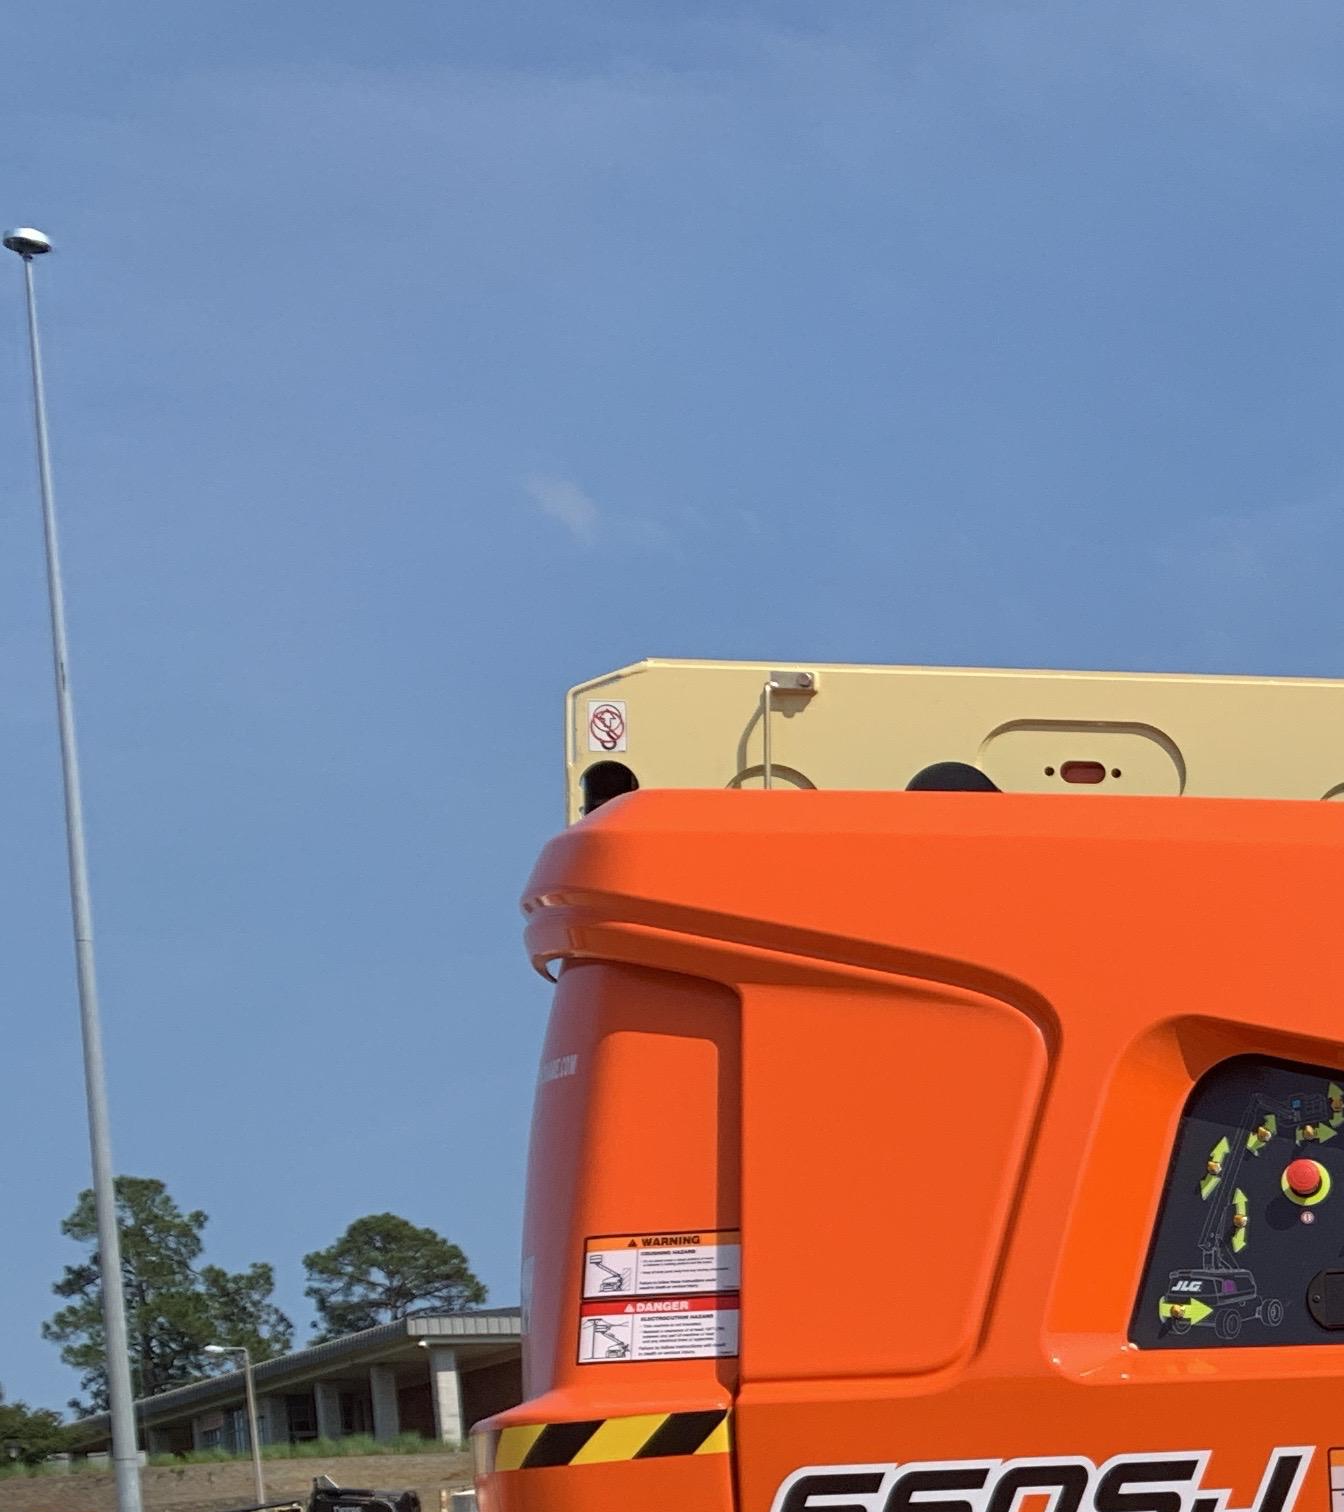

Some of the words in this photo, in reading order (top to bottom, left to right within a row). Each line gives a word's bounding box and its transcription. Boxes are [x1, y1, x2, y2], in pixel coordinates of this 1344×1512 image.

[641, 1235, 700, 1247] WARNING
[1171, 1280, 1203, 1291] JLG
[635, 1301, 689, 1312] DANGER
